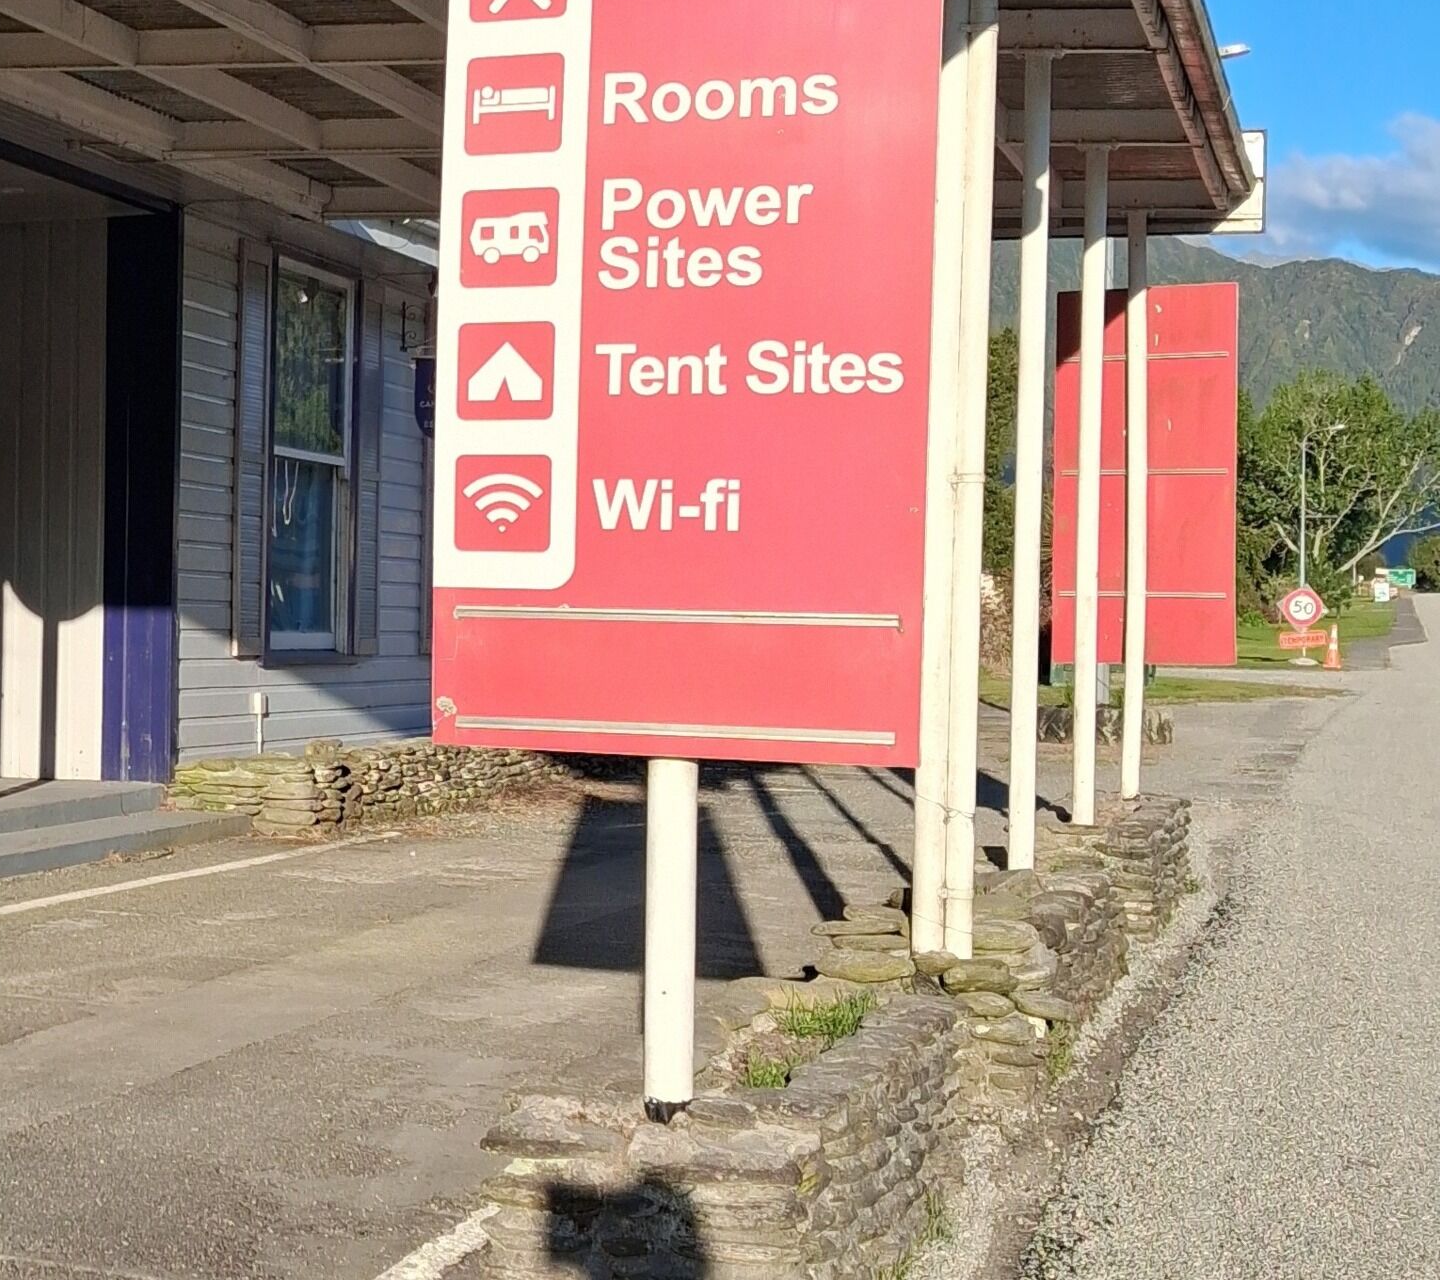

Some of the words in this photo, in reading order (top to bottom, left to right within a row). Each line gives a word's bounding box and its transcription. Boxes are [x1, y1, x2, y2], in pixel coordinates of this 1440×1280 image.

[602, 71, 840, 125] Rooms
[600, 177, 814, 231] Power
[597, 235, 763, 290] Sites
[594, 342, 728, 396] Tent
[745, 339, 906, 395] Sites
[591, 478, 742, 532] Wi-fi
[1293, 601, 1314, 615] 50
